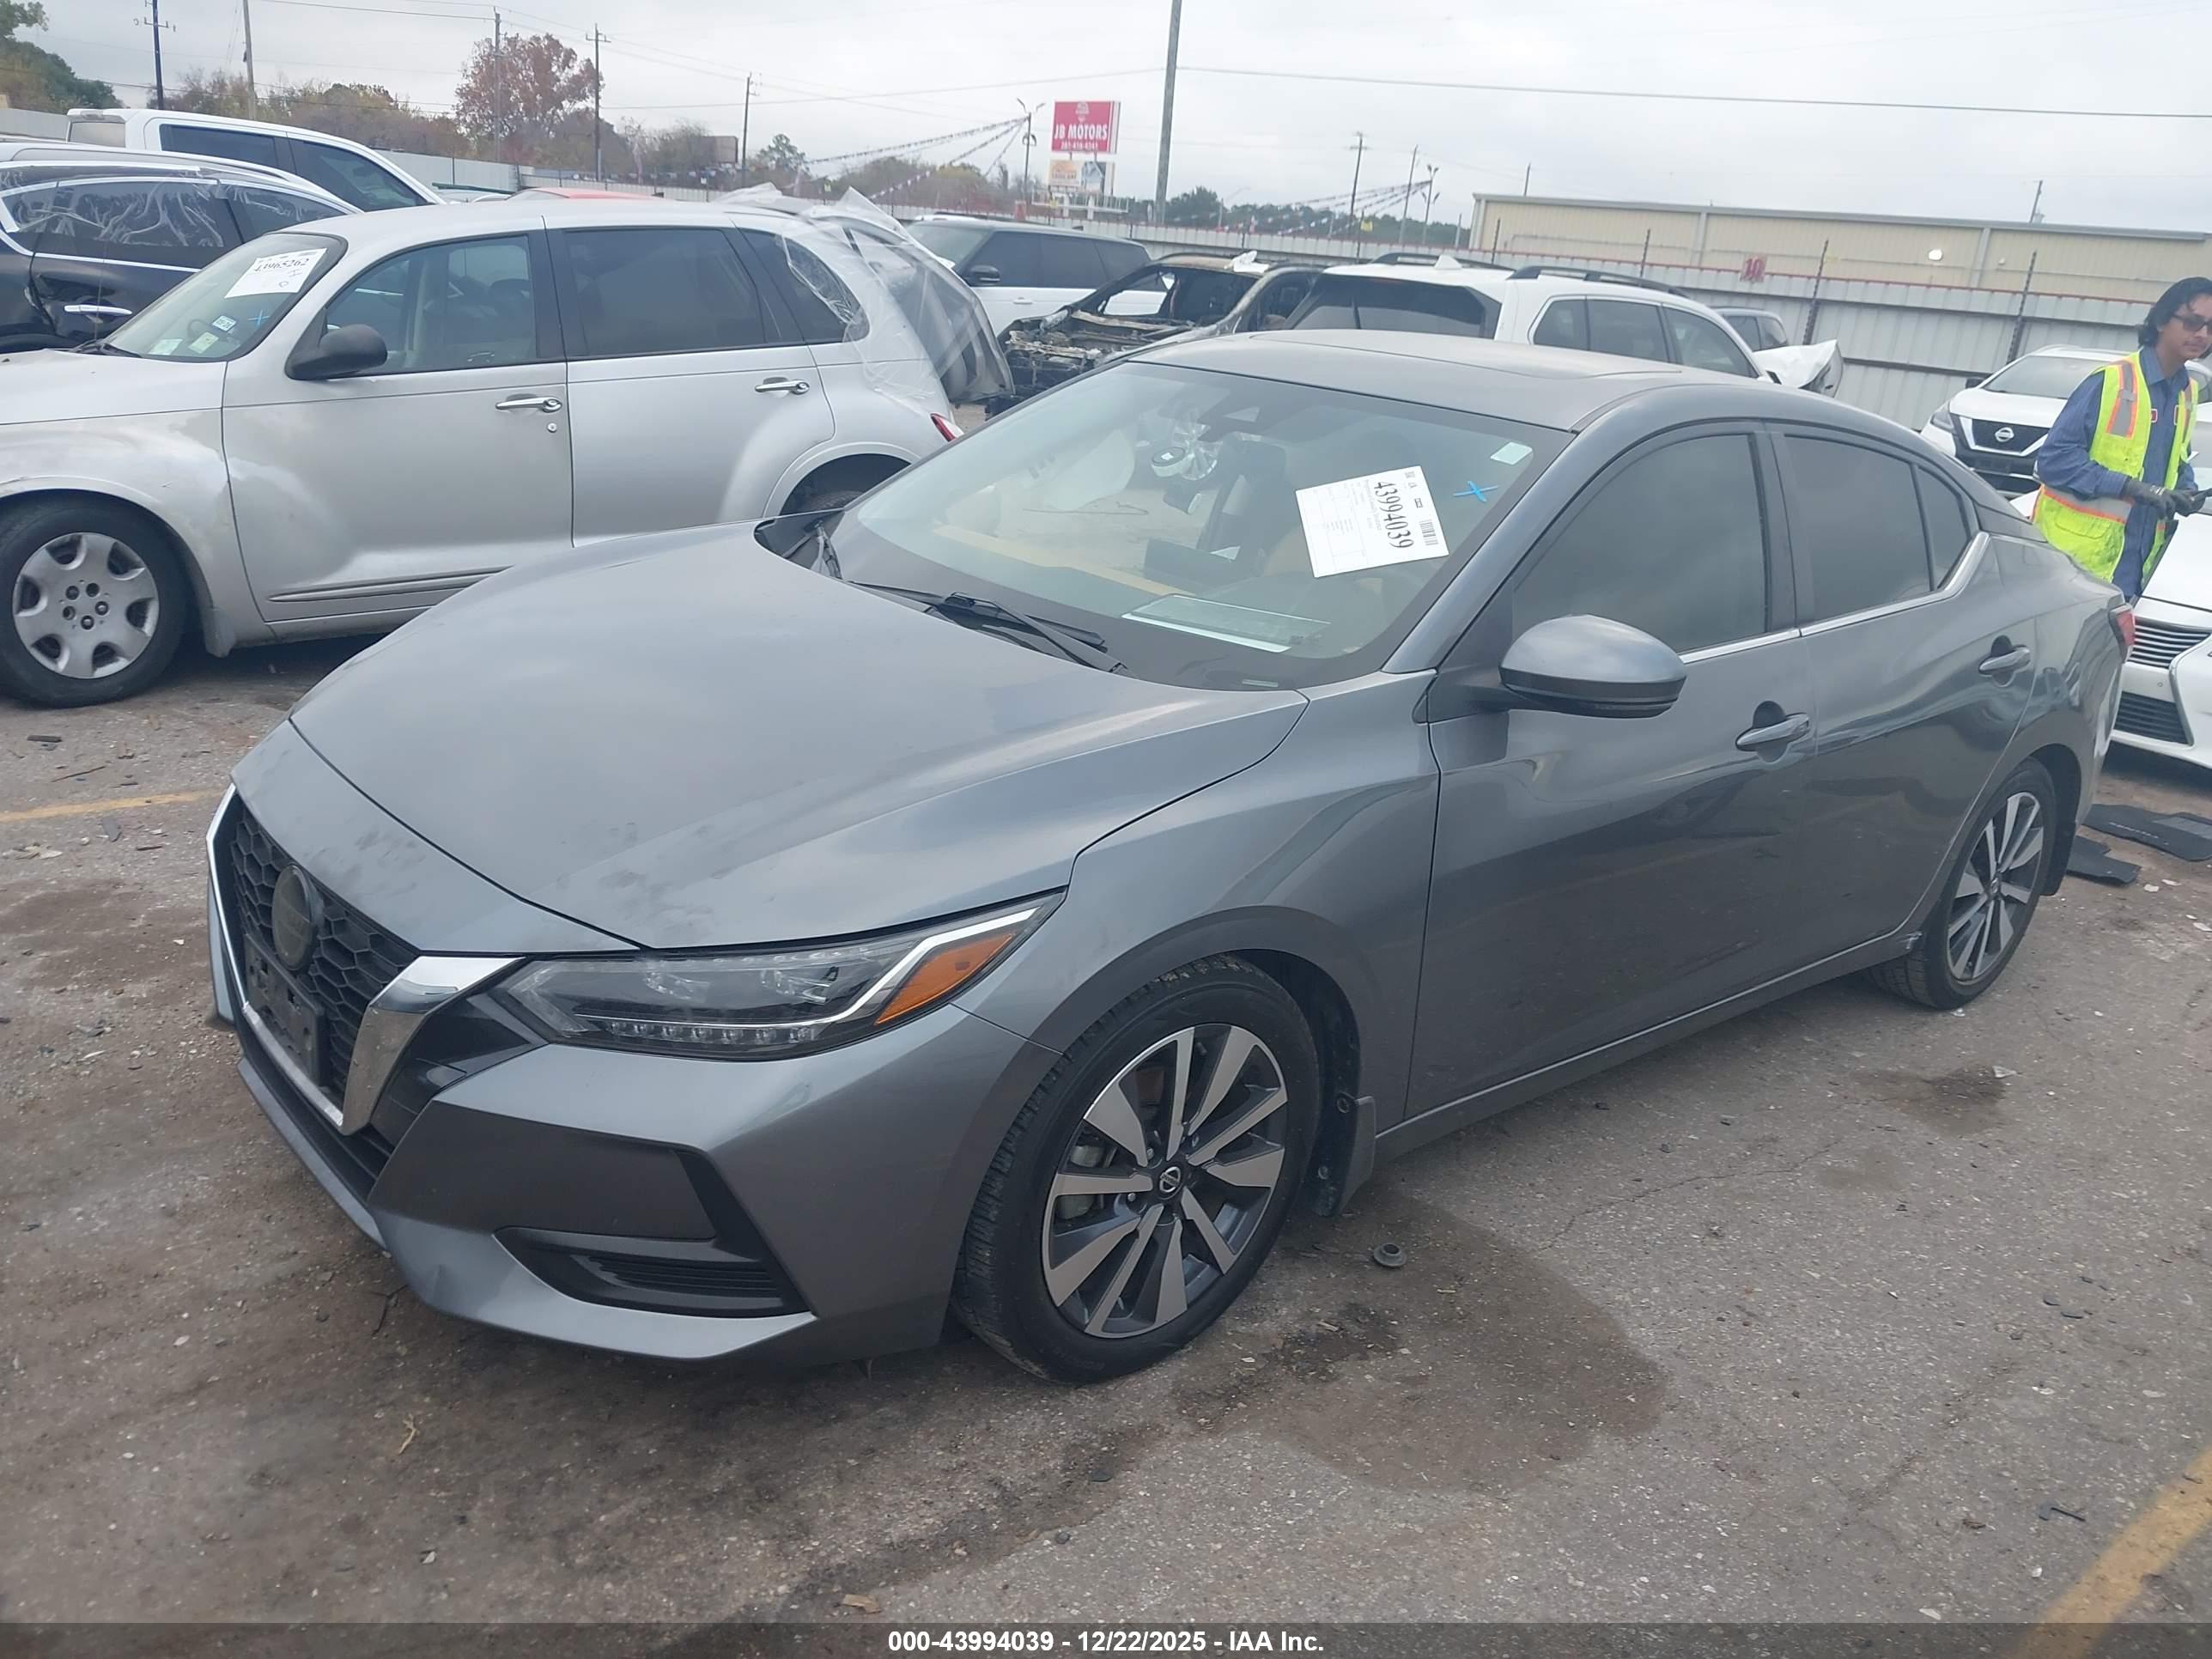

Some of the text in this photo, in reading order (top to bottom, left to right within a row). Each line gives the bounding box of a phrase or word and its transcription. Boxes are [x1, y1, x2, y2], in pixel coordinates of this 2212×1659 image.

[1054, 124, 1109, 140] JB MOTORS
[1374, 481, 1415, 550] 43994039
